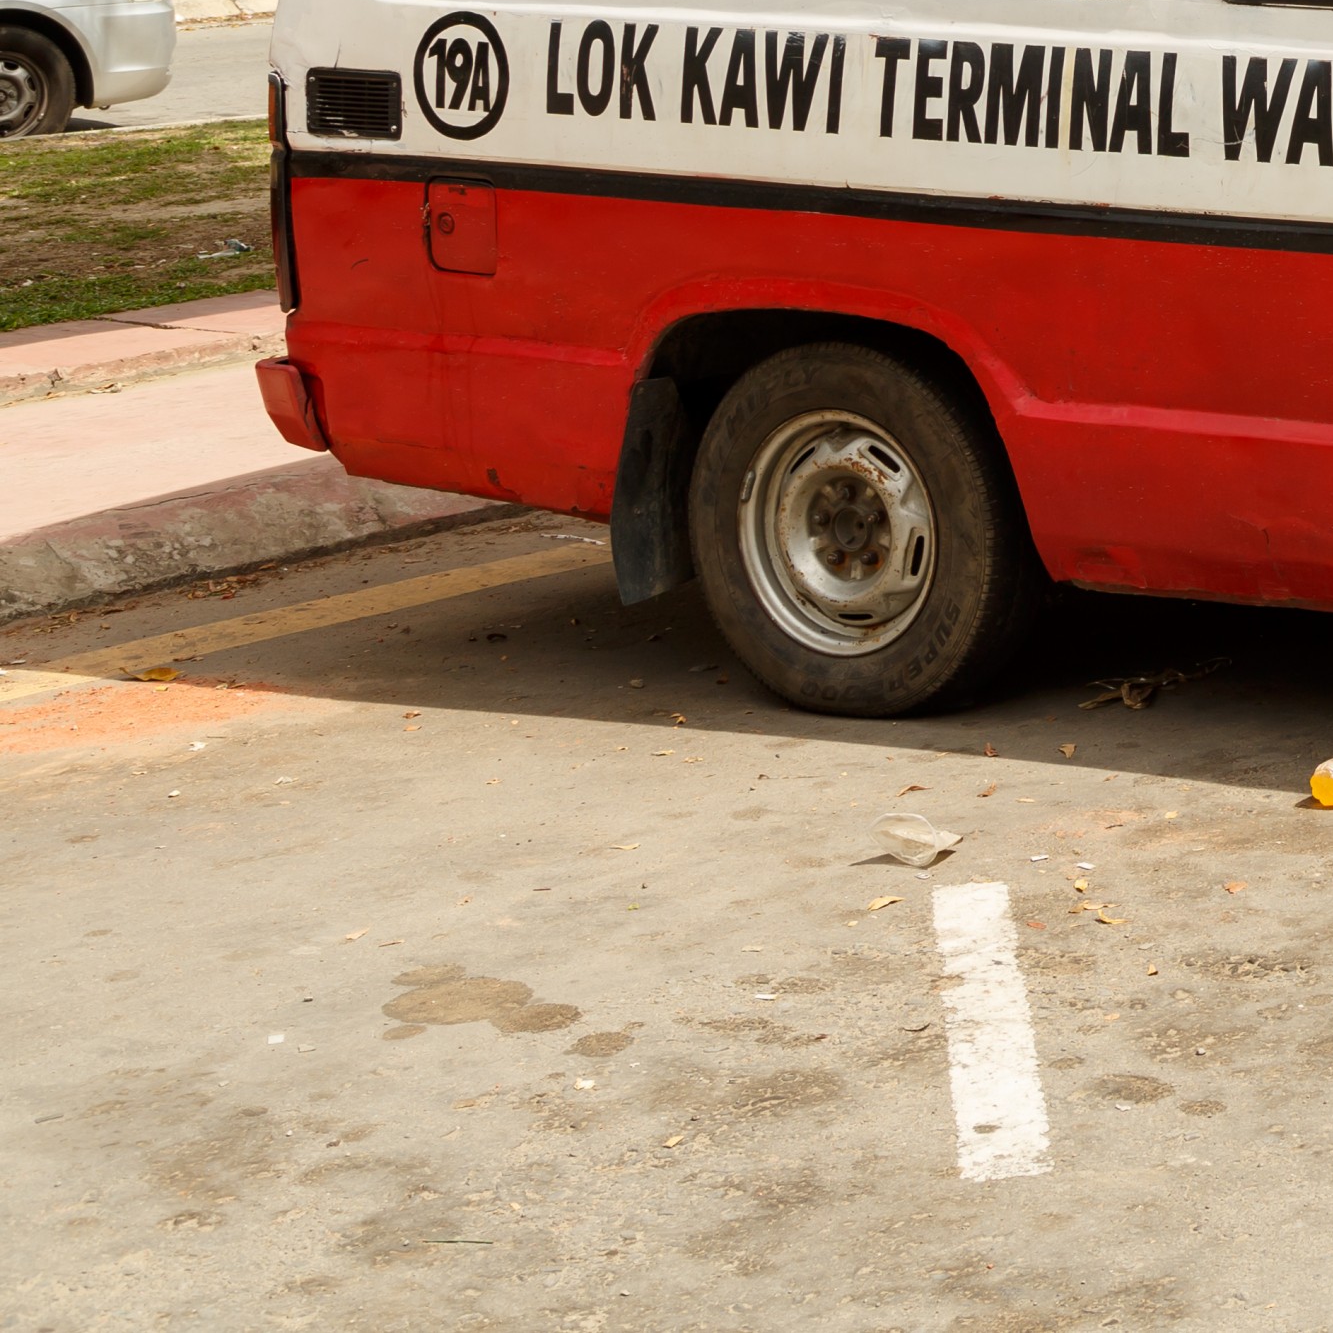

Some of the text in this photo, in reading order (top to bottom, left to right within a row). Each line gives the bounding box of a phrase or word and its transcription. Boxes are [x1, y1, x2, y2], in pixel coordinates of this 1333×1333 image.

[430, 37, 493, 113] 19A
[547, 20, 659, 121] LOK
[680, 26, 847, 135] KAWI
[875, 35, 1190, 158] TERMINAL
